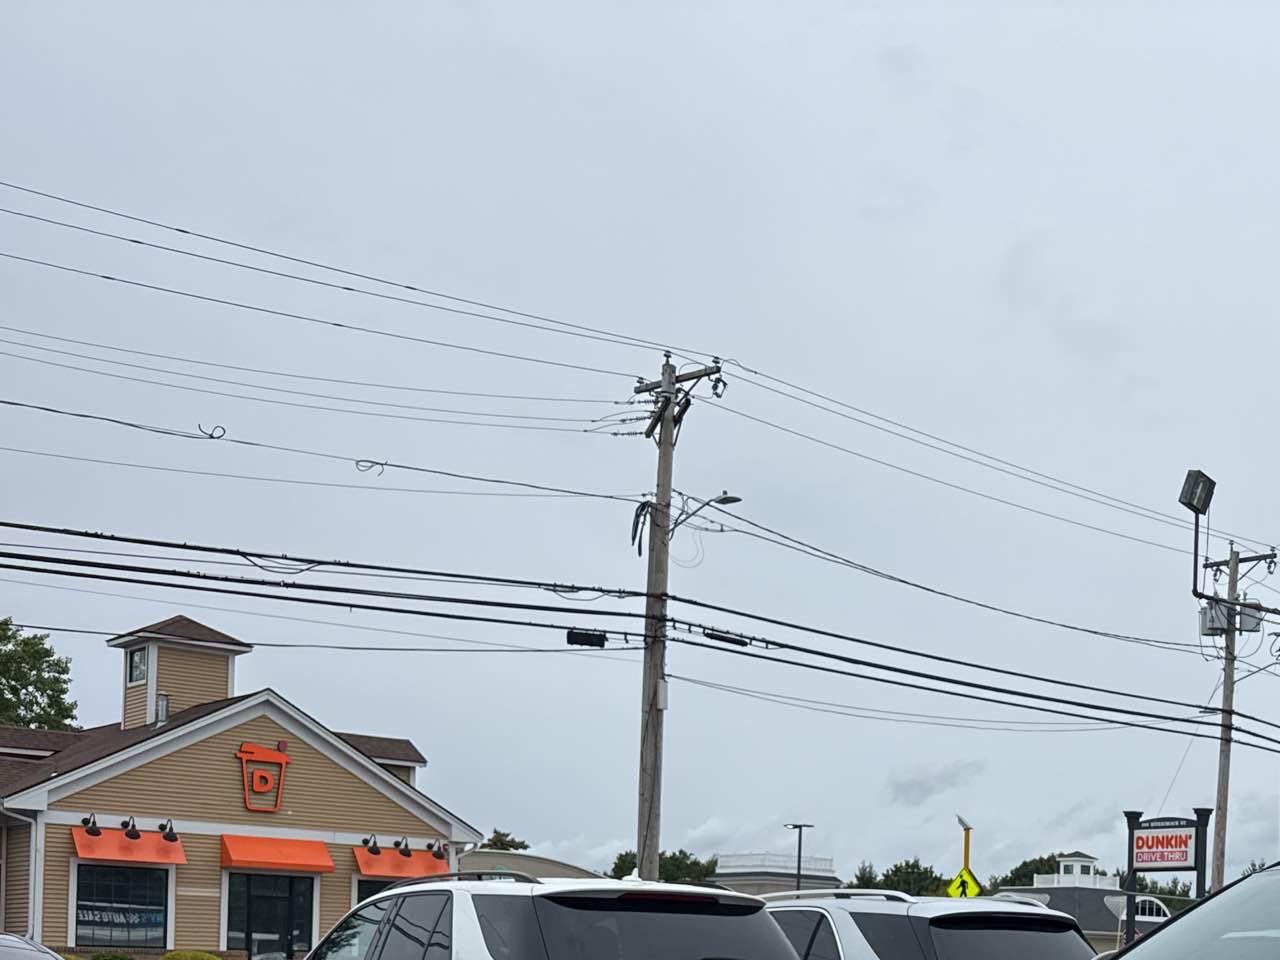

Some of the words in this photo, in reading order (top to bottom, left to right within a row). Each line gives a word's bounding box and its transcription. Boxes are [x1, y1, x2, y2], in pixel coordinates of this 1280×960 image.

[253, 769, 274, 793] D
[1135, 834, 1192, 850] DUNKIN'
[1137, 852, 1161, 862] DRIVE
[1163, 851, 1186, 861] THRU
